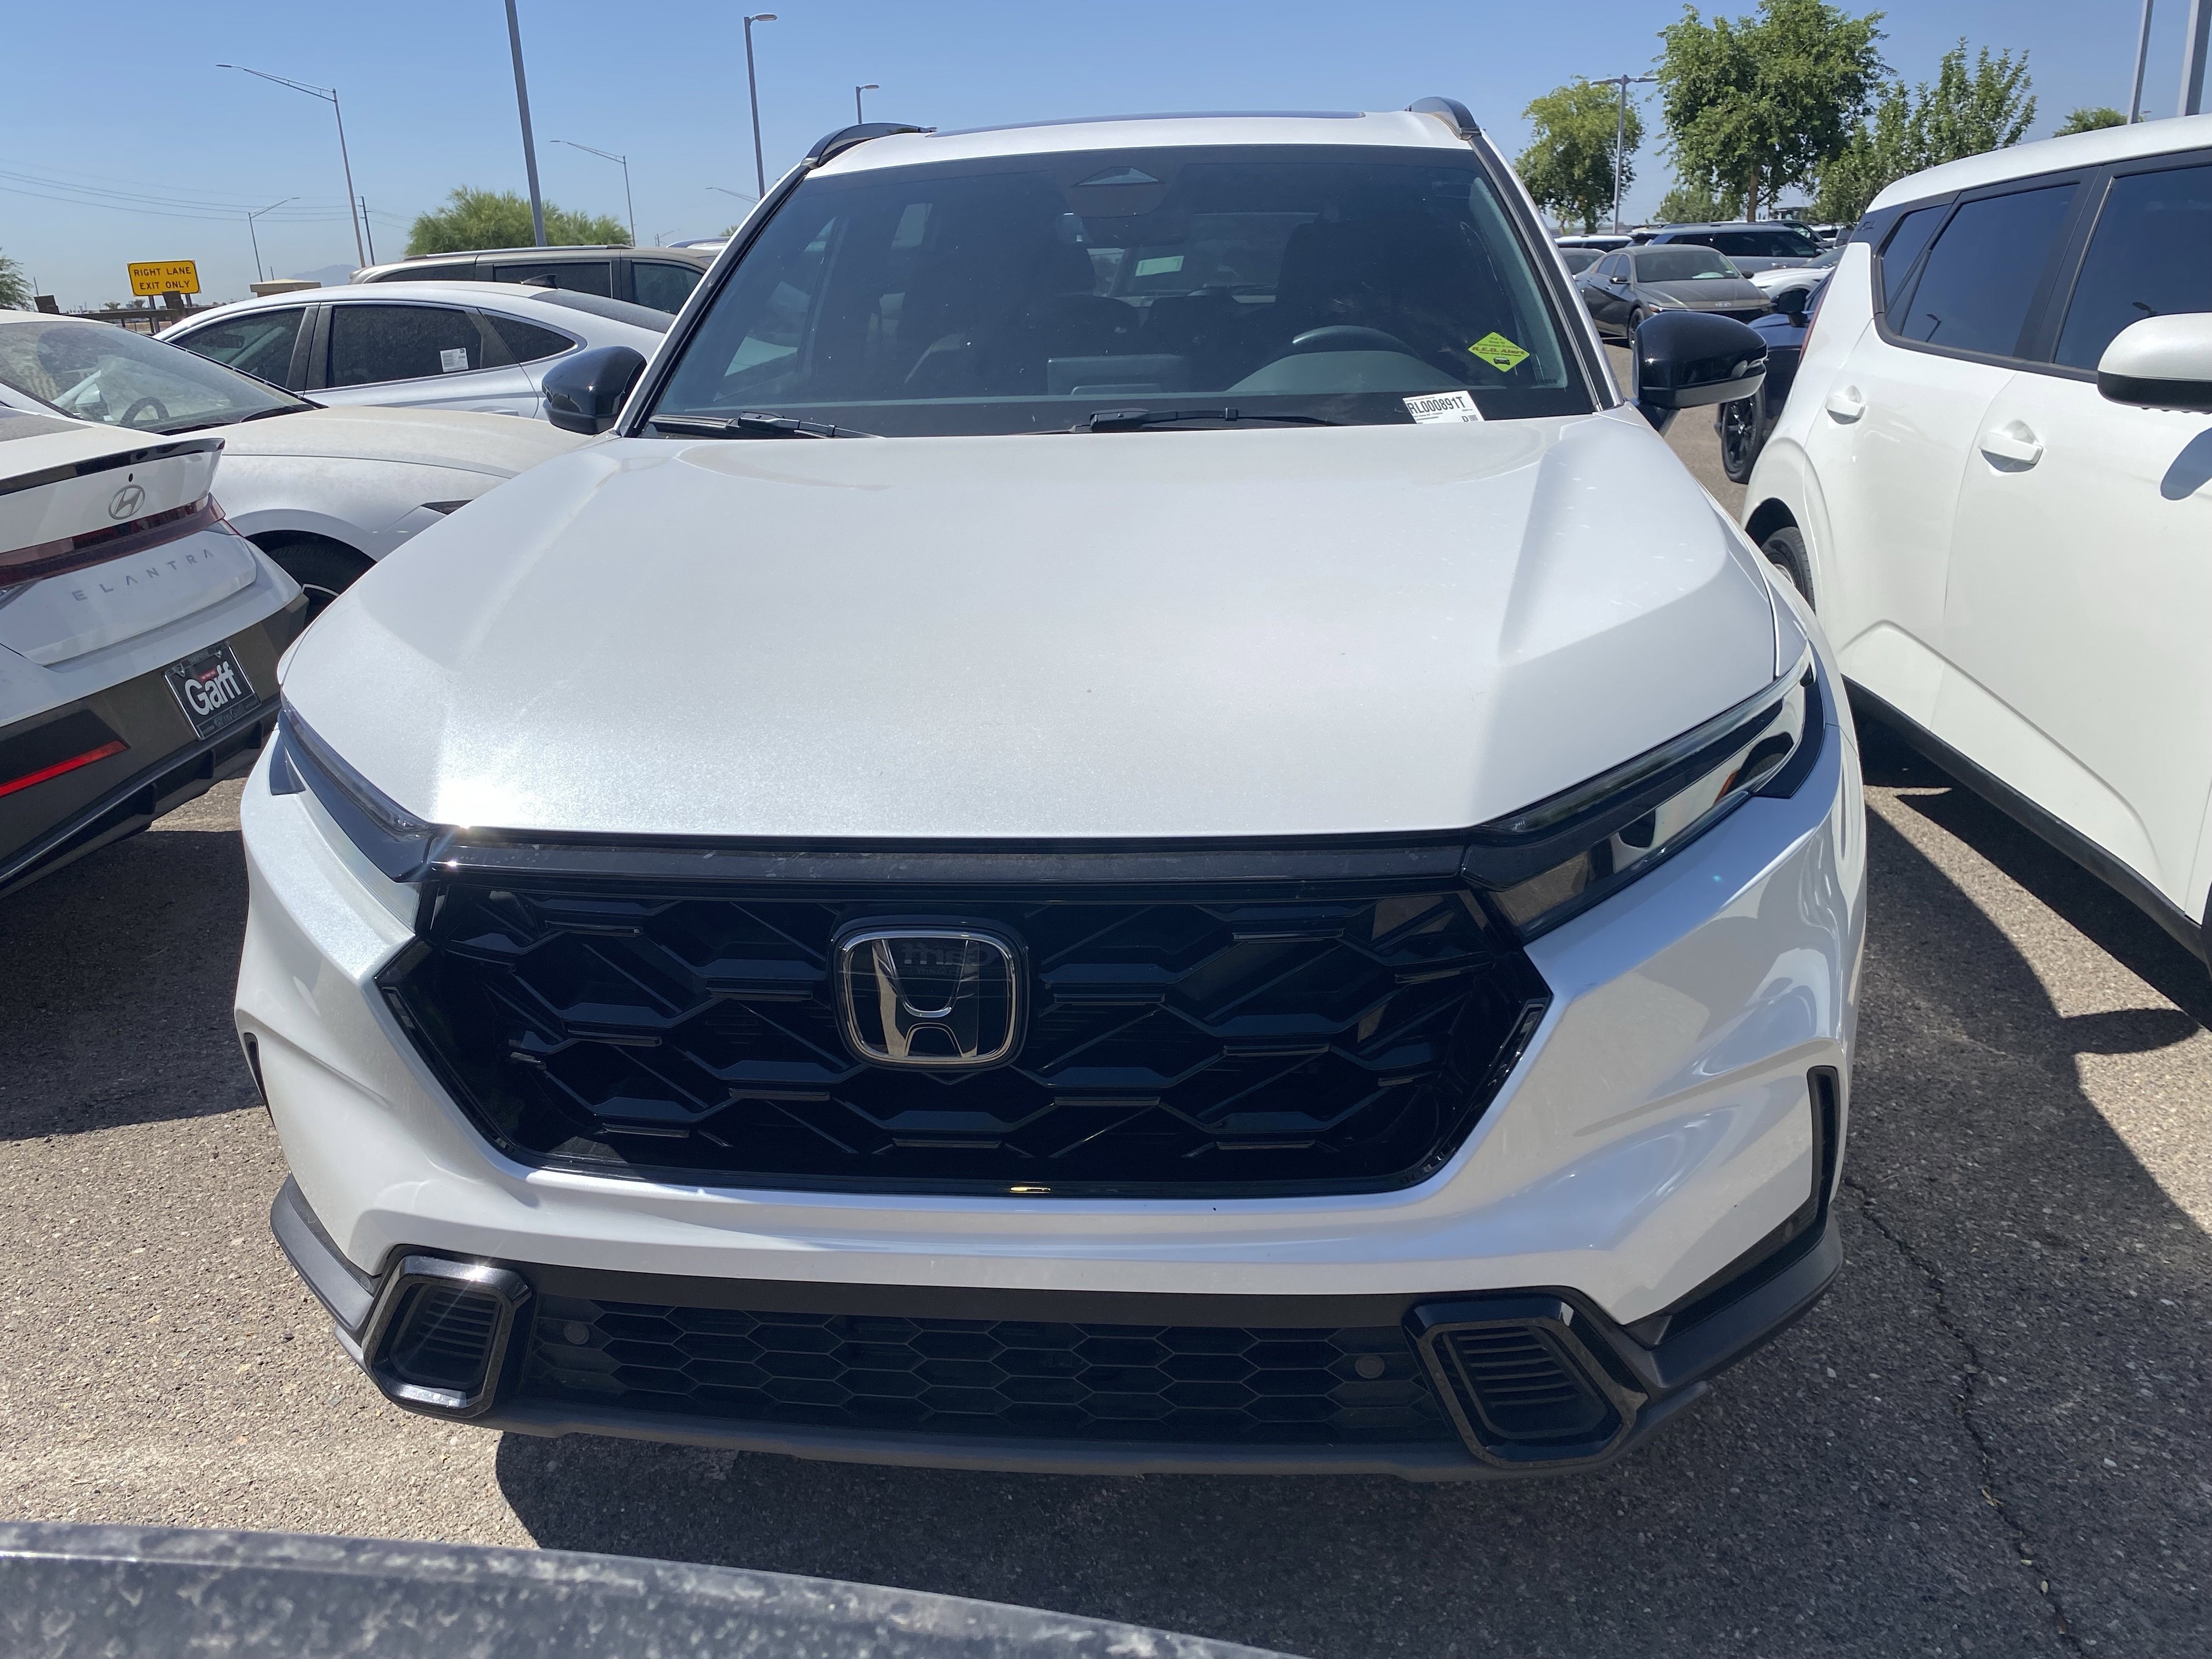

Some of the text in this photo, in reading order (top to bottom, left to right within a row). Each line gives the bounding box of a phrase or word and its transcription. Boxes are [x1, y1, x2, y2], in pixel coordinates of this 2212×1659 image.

[134, 267, 191, 276] RIGHT LANE
[139, 280, 190, 290] EXIT ONLY
[1406, 397, 1466, 414] RL000891T
[71, 549, 213, 601] ELANTRA
[184, 661, 242, 716] Garff
